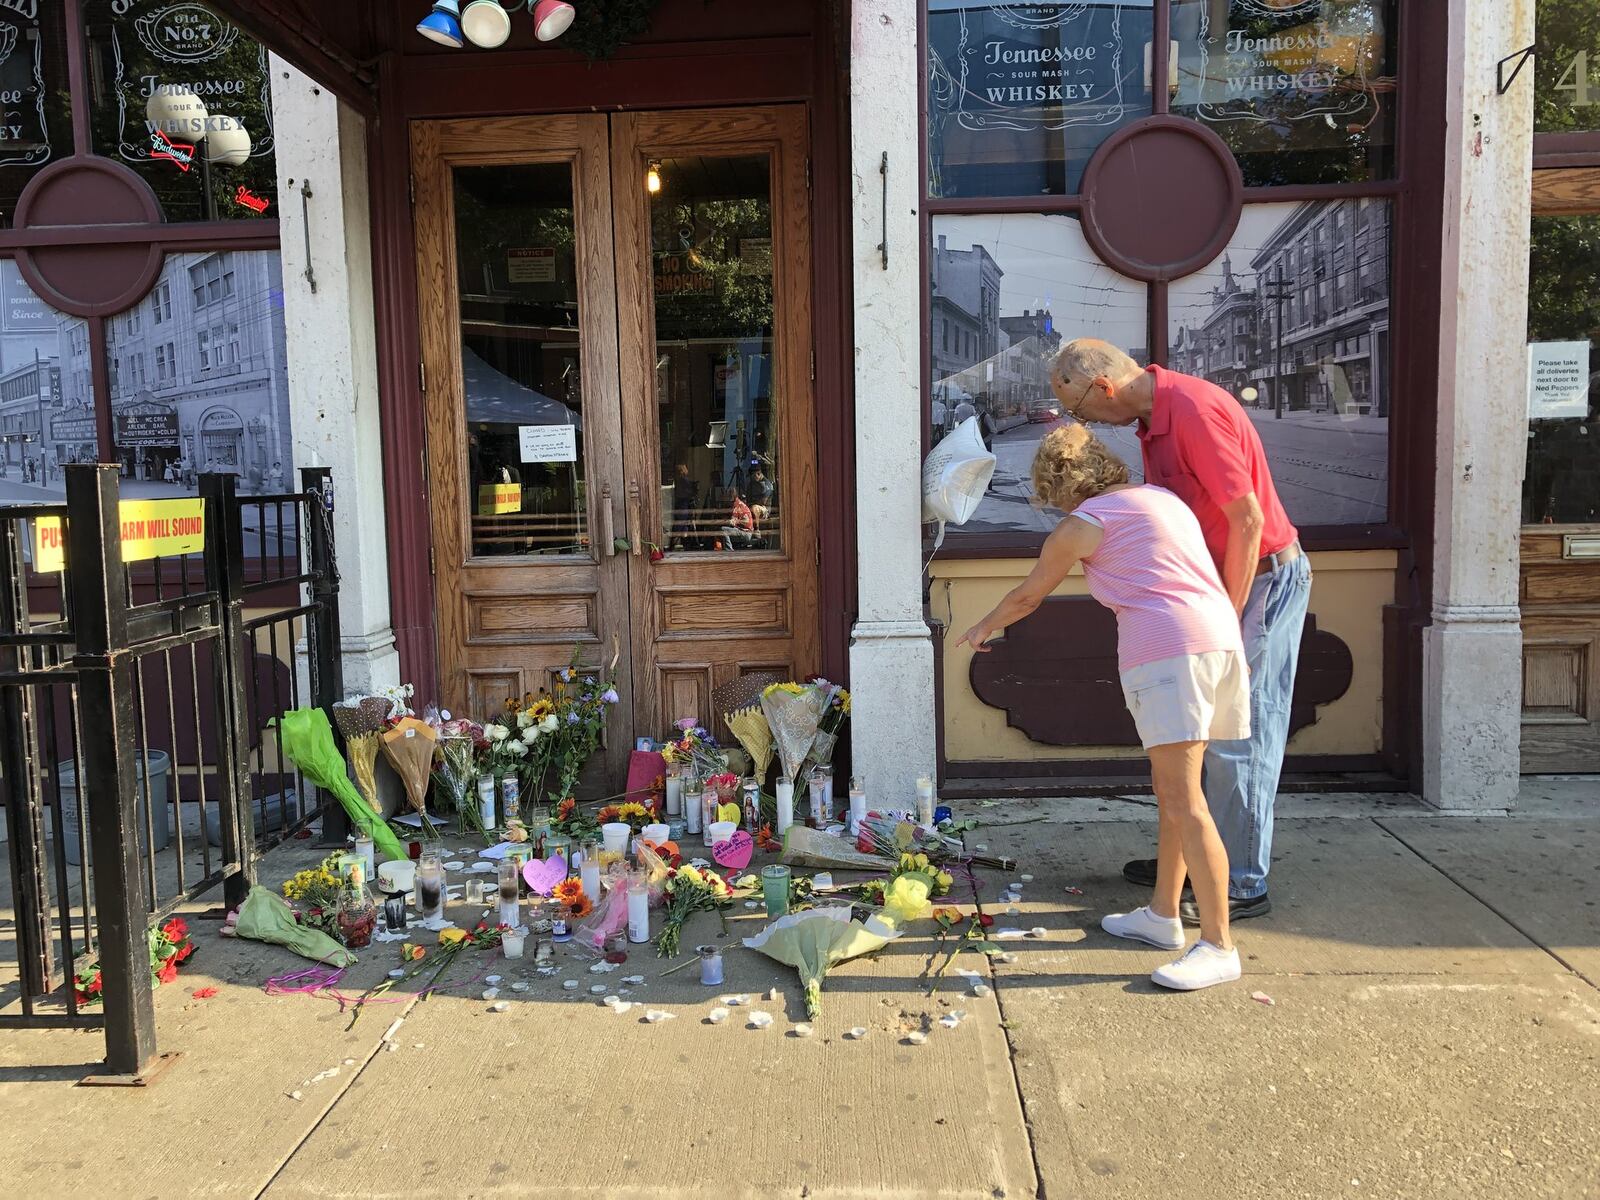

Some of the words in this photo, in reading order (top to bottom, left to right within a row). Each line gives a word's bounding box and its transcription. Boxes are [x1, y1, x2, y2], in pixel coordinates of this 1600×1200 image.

[174, 14, 199, 24] Old
[1225, 29, 1336, 53] Tennesse
[984, 41, 1096, 65] Tennessee
[1253, 59, 1279, 68] SOUR
[1284, 58, 1312, 66] MASH
[1011, 71, 1037, 79] SOUR
[1042, 69, 1070, 77] MASH
[1228, 72, 1337, 91] WHISKEY
[1553, 50, 1600, 107] 4
[140, 75, 246, 98] Tennessee
[986, 83, 1095, 102] WHISKEY
[168, 103, 192, 111] SOUR
[196, 101, 222, 109] MASH
[144, 115, 246, 134] WHISKEY
[662, 256, 680, 273] NO
[654, 273, 712, 292] SMOKING
[11, 310, 43, 319] Since
[121, 521, 145, 541] ARM
[147, 518, 170, 539] WILL
[172, 516, 202, 537] SOUND
